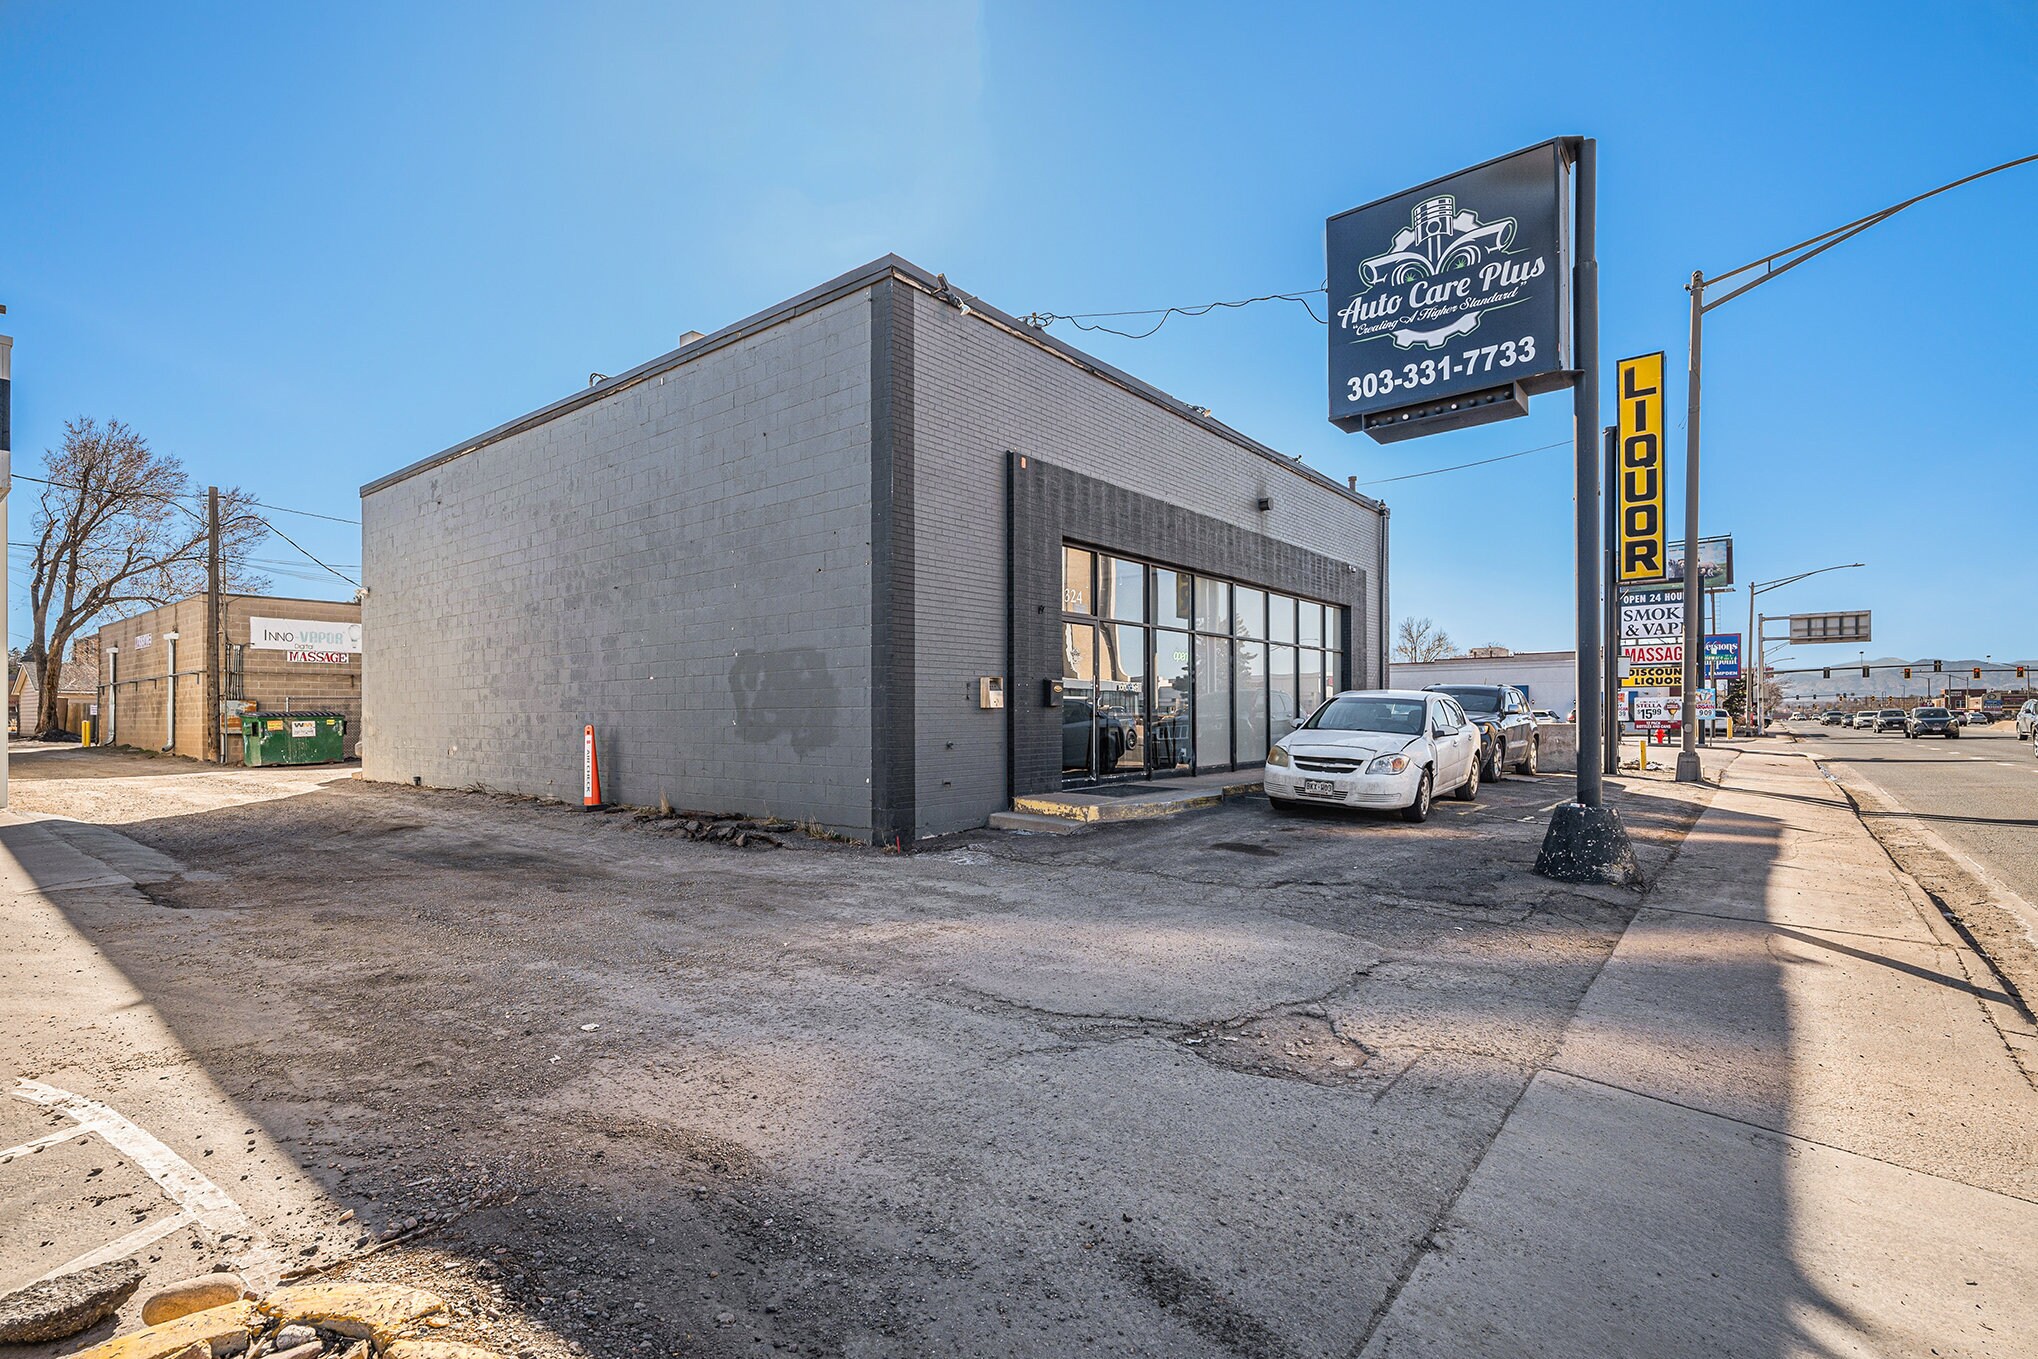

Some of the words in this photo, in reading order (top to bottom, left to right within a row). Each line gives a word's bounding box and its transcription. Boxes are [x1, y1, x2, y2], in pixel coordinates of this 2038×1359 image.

[1337, 292, 1402, 328] Auto
[1409, 279, 1470, 308] Care
[1478, 256, 1546, 292] Plus
[1399, 313, 1417, 325] A
[1416, 305, 1459, 323] Higher
[1347, 336, 1537, 402] 303-331-7733
[1624, 366, 1660, 573] LIQUOR
[1064, 589, 1083, 604] 324
[1623, 594, 1646, 604] OPEN
[1649, 593, 1661, 602] 24
[1664, 592, 1684, 601] HOU
[1623, 606, 1684, 622] SMOK
[1625, 624, 1640, 637] &
[289, 652, 348, 663] MASSAGE
[1625, 646, 1682, 662] MASSAG
[1629, 668, 1682, 676] DISCOUN
[1635, 677, 1682, 685] LIQUOR
